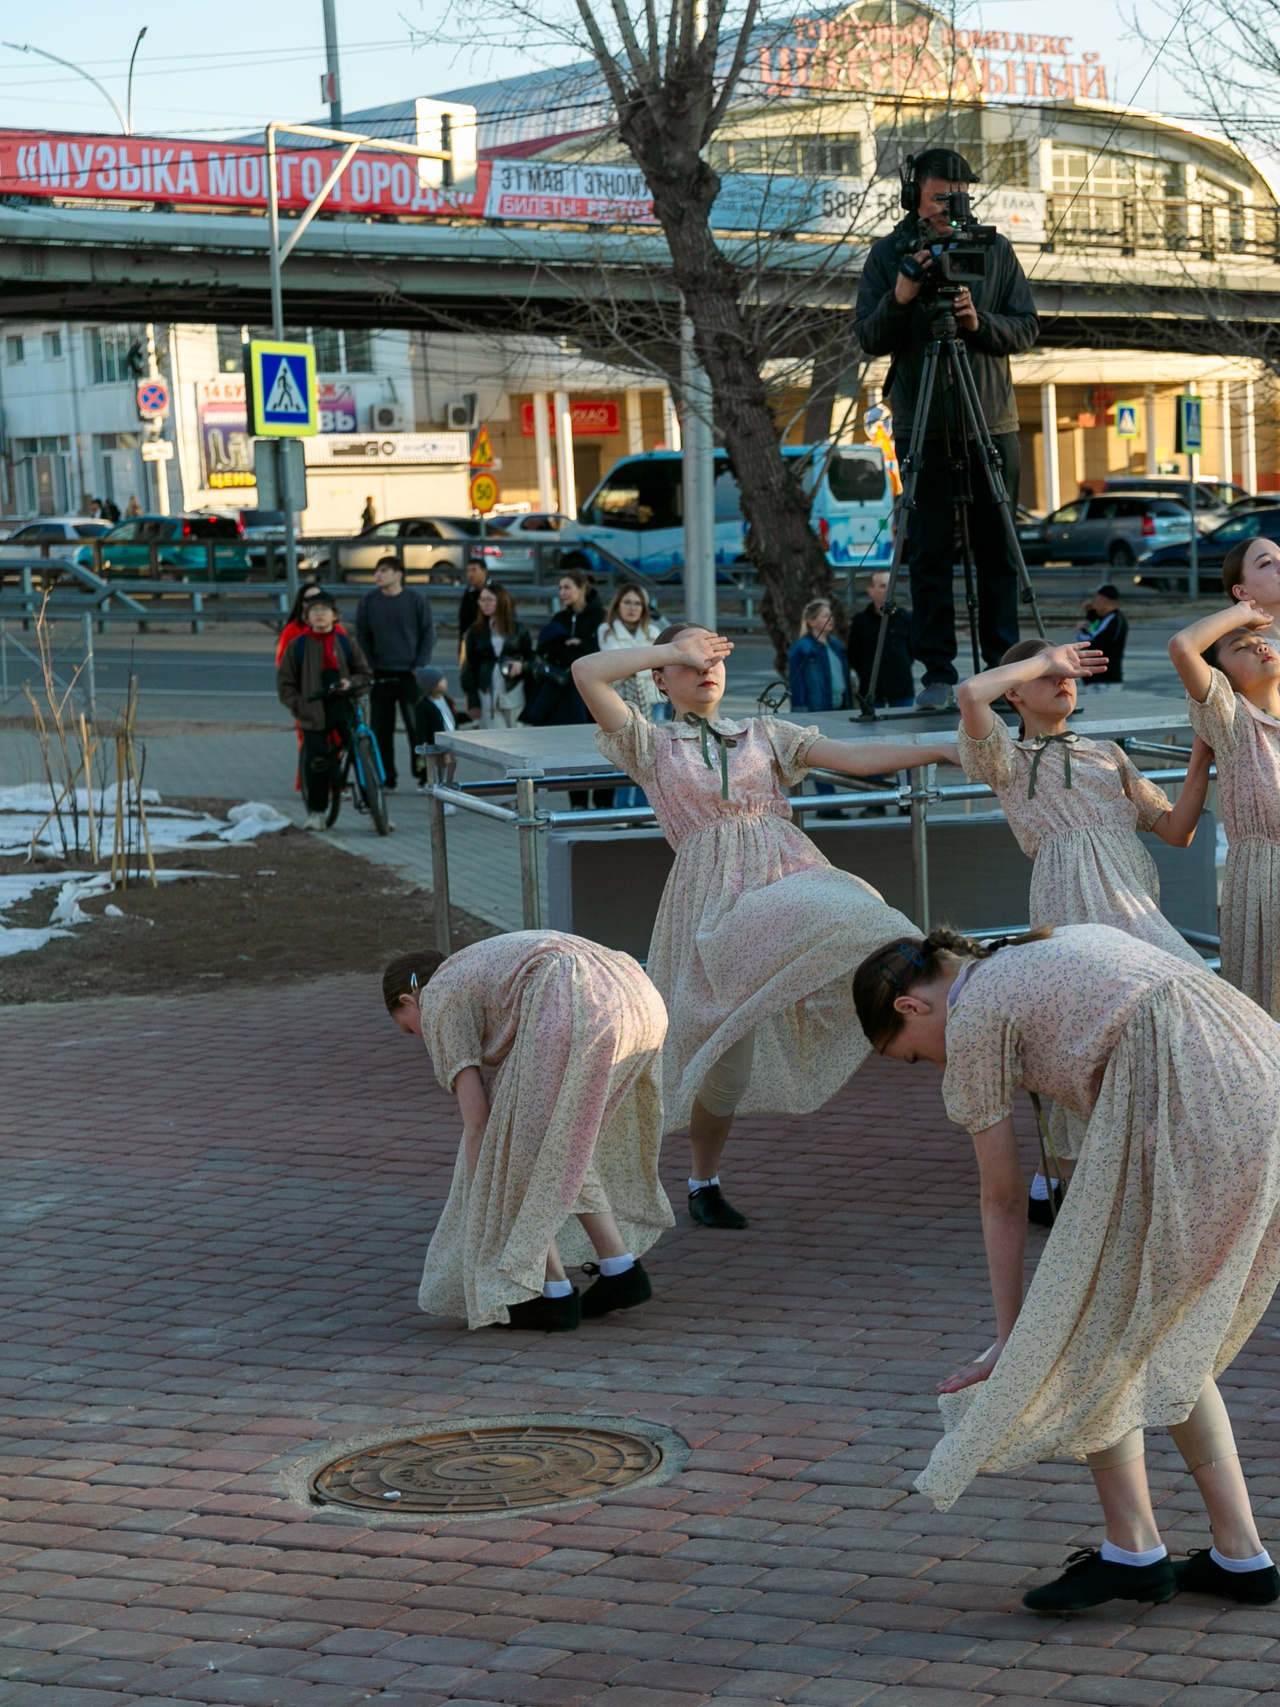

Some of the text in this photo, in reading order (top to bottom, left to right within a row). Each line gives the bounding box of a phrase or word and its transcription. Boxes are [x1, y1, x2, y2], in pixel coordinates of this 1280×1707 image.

[16, 141, 200, 195] «МУЗЫКА
[204, 385, 220, 399] 14
[476, 483, 491, 500] 50
